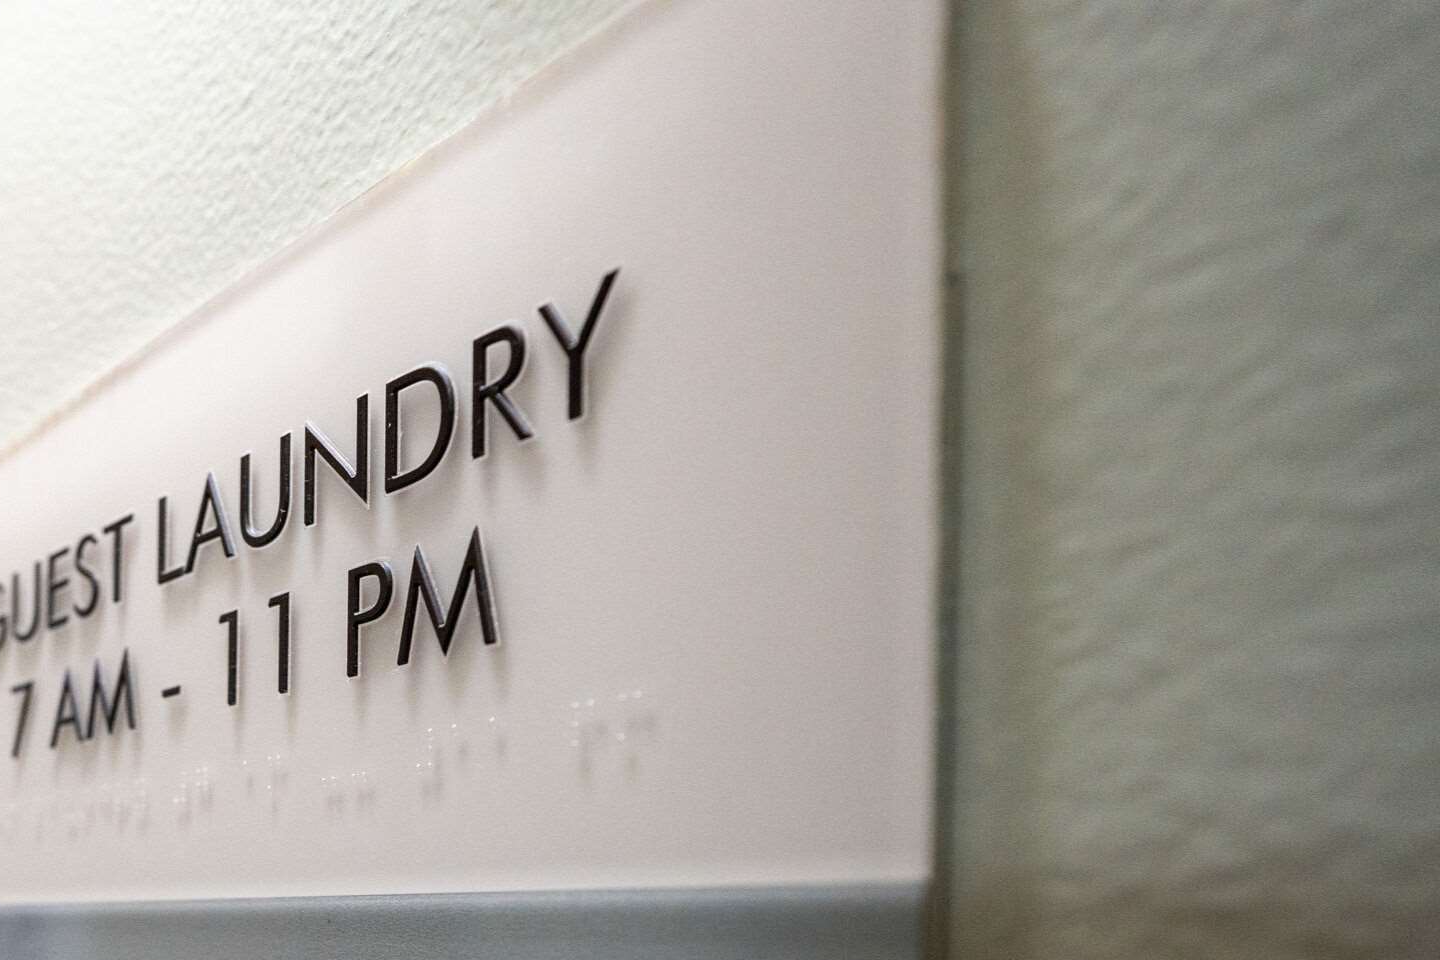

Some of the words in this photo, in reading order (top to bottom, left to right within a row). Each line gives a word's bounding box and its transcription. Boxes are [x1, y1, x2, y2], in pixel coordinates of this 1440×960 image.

[157, 266, 621, 586] LAUNDRY
[11, 682, 35, 759] 7
[49, 647, 137, 750] AM
[161, 684, 182, 701] -
[218, 591, 291, 707] 11
[346, 525, 501, 682] PM
